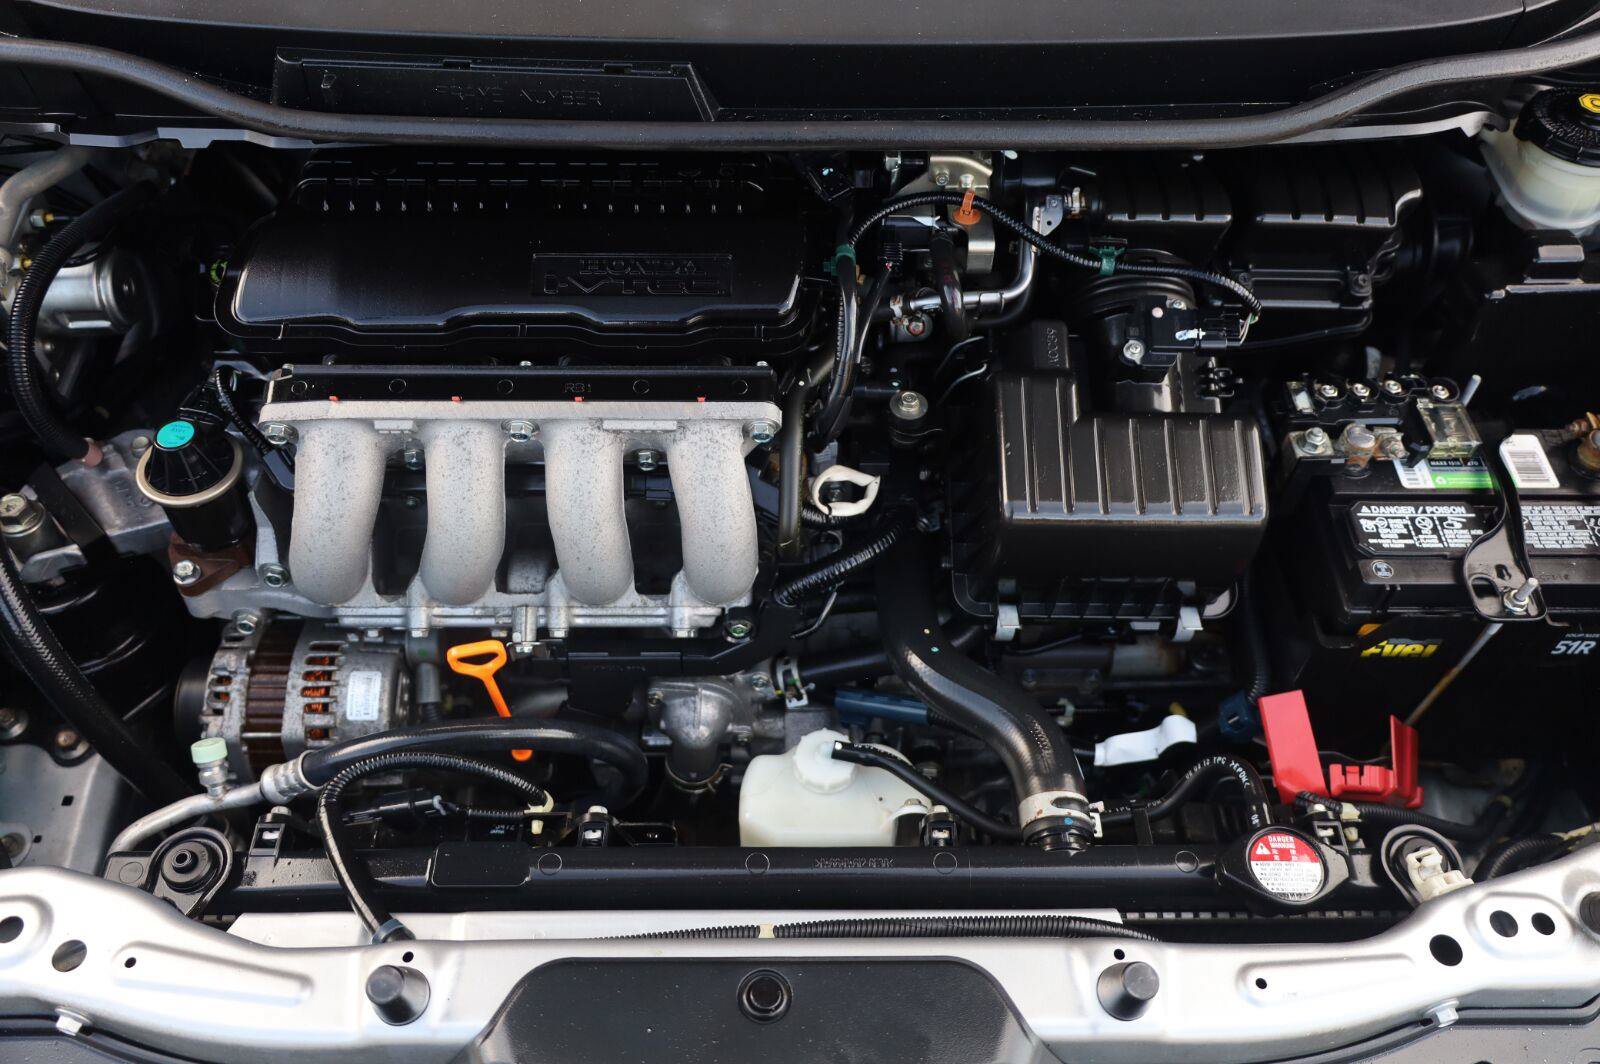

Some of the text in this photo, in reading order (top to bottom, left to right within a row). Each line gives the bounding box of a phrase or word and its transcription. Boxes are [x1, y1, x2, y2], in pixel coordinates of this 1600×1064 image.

[579, 259, 708, 275] HONDA
[1370, 505, 1416, 514] DANGER
[1425, 505, 1466, 514] POISON
[1551, 639, 1597, 655] 51R
[1267, 835, 1296, 843] DANGER
